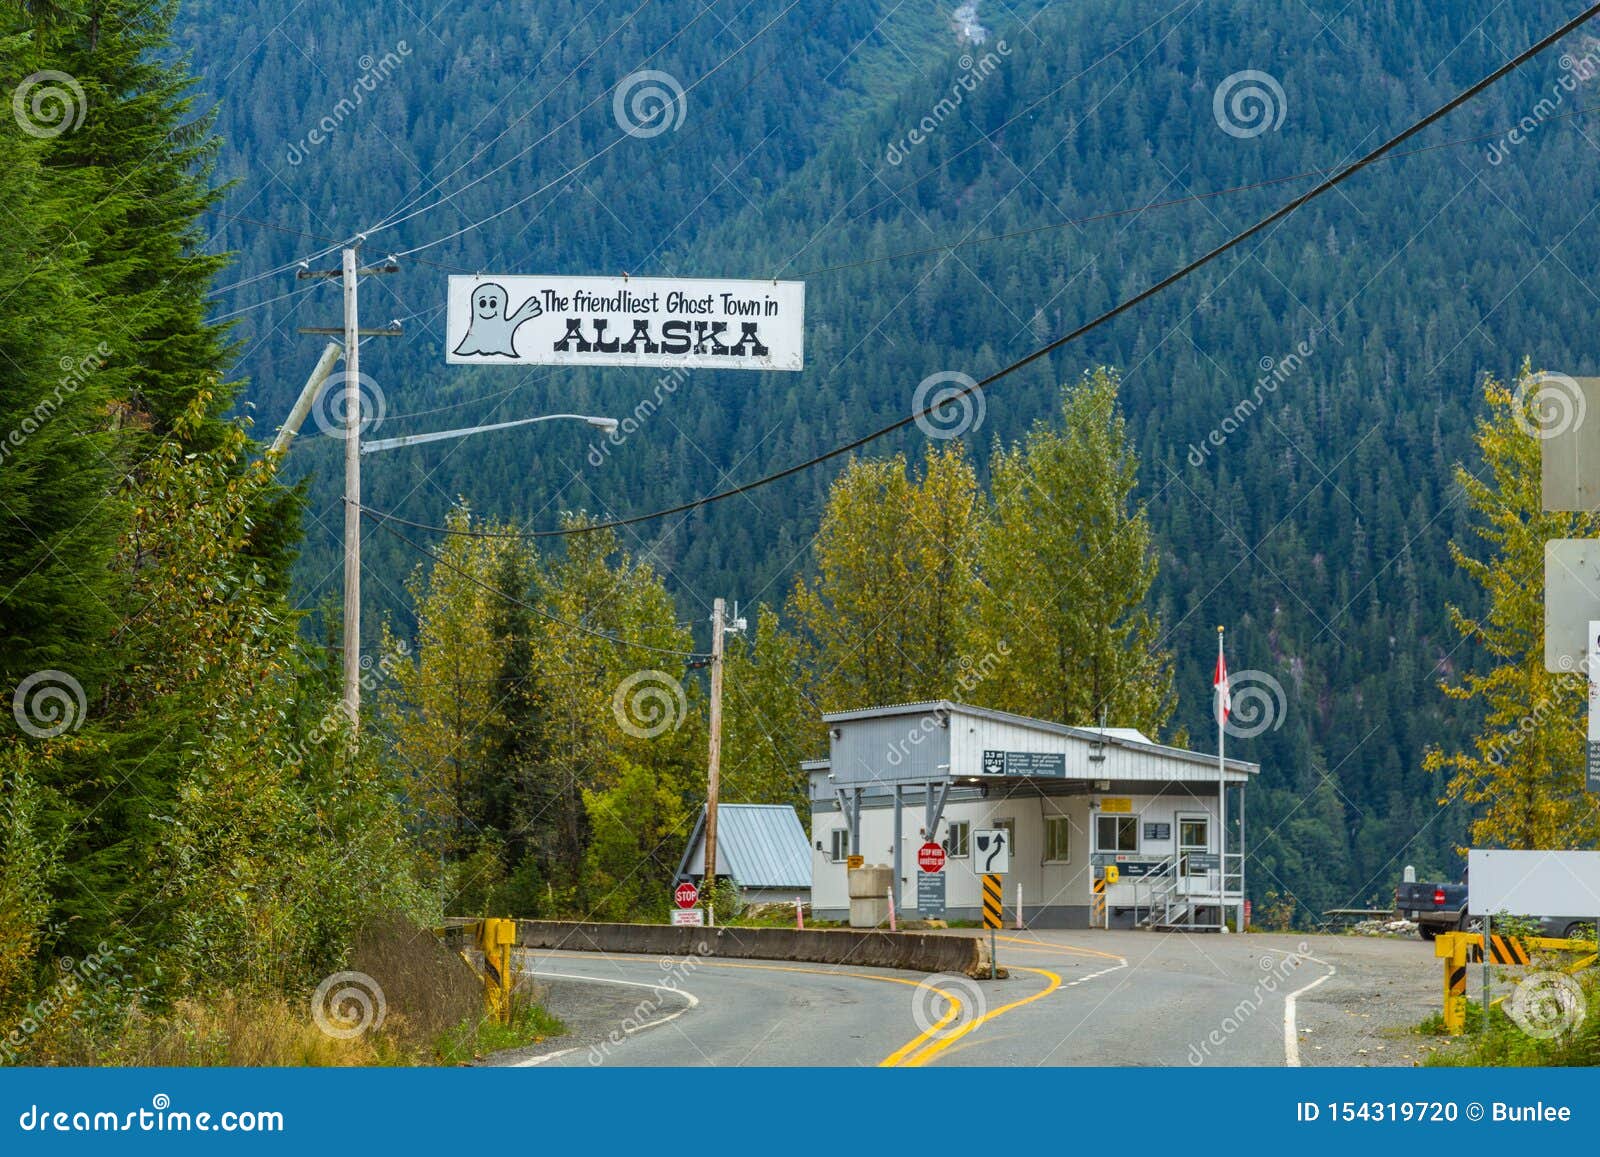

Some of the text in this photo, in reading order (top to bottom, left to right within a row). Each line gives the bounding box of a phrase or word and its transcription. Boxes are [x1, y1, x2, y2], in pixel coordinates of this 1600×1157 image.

[541, 289, 778, 317] The friendliest Ghost Town in
[553, 318, 769, 356] ALASKA
[677, 891, 696, 902] STOP
